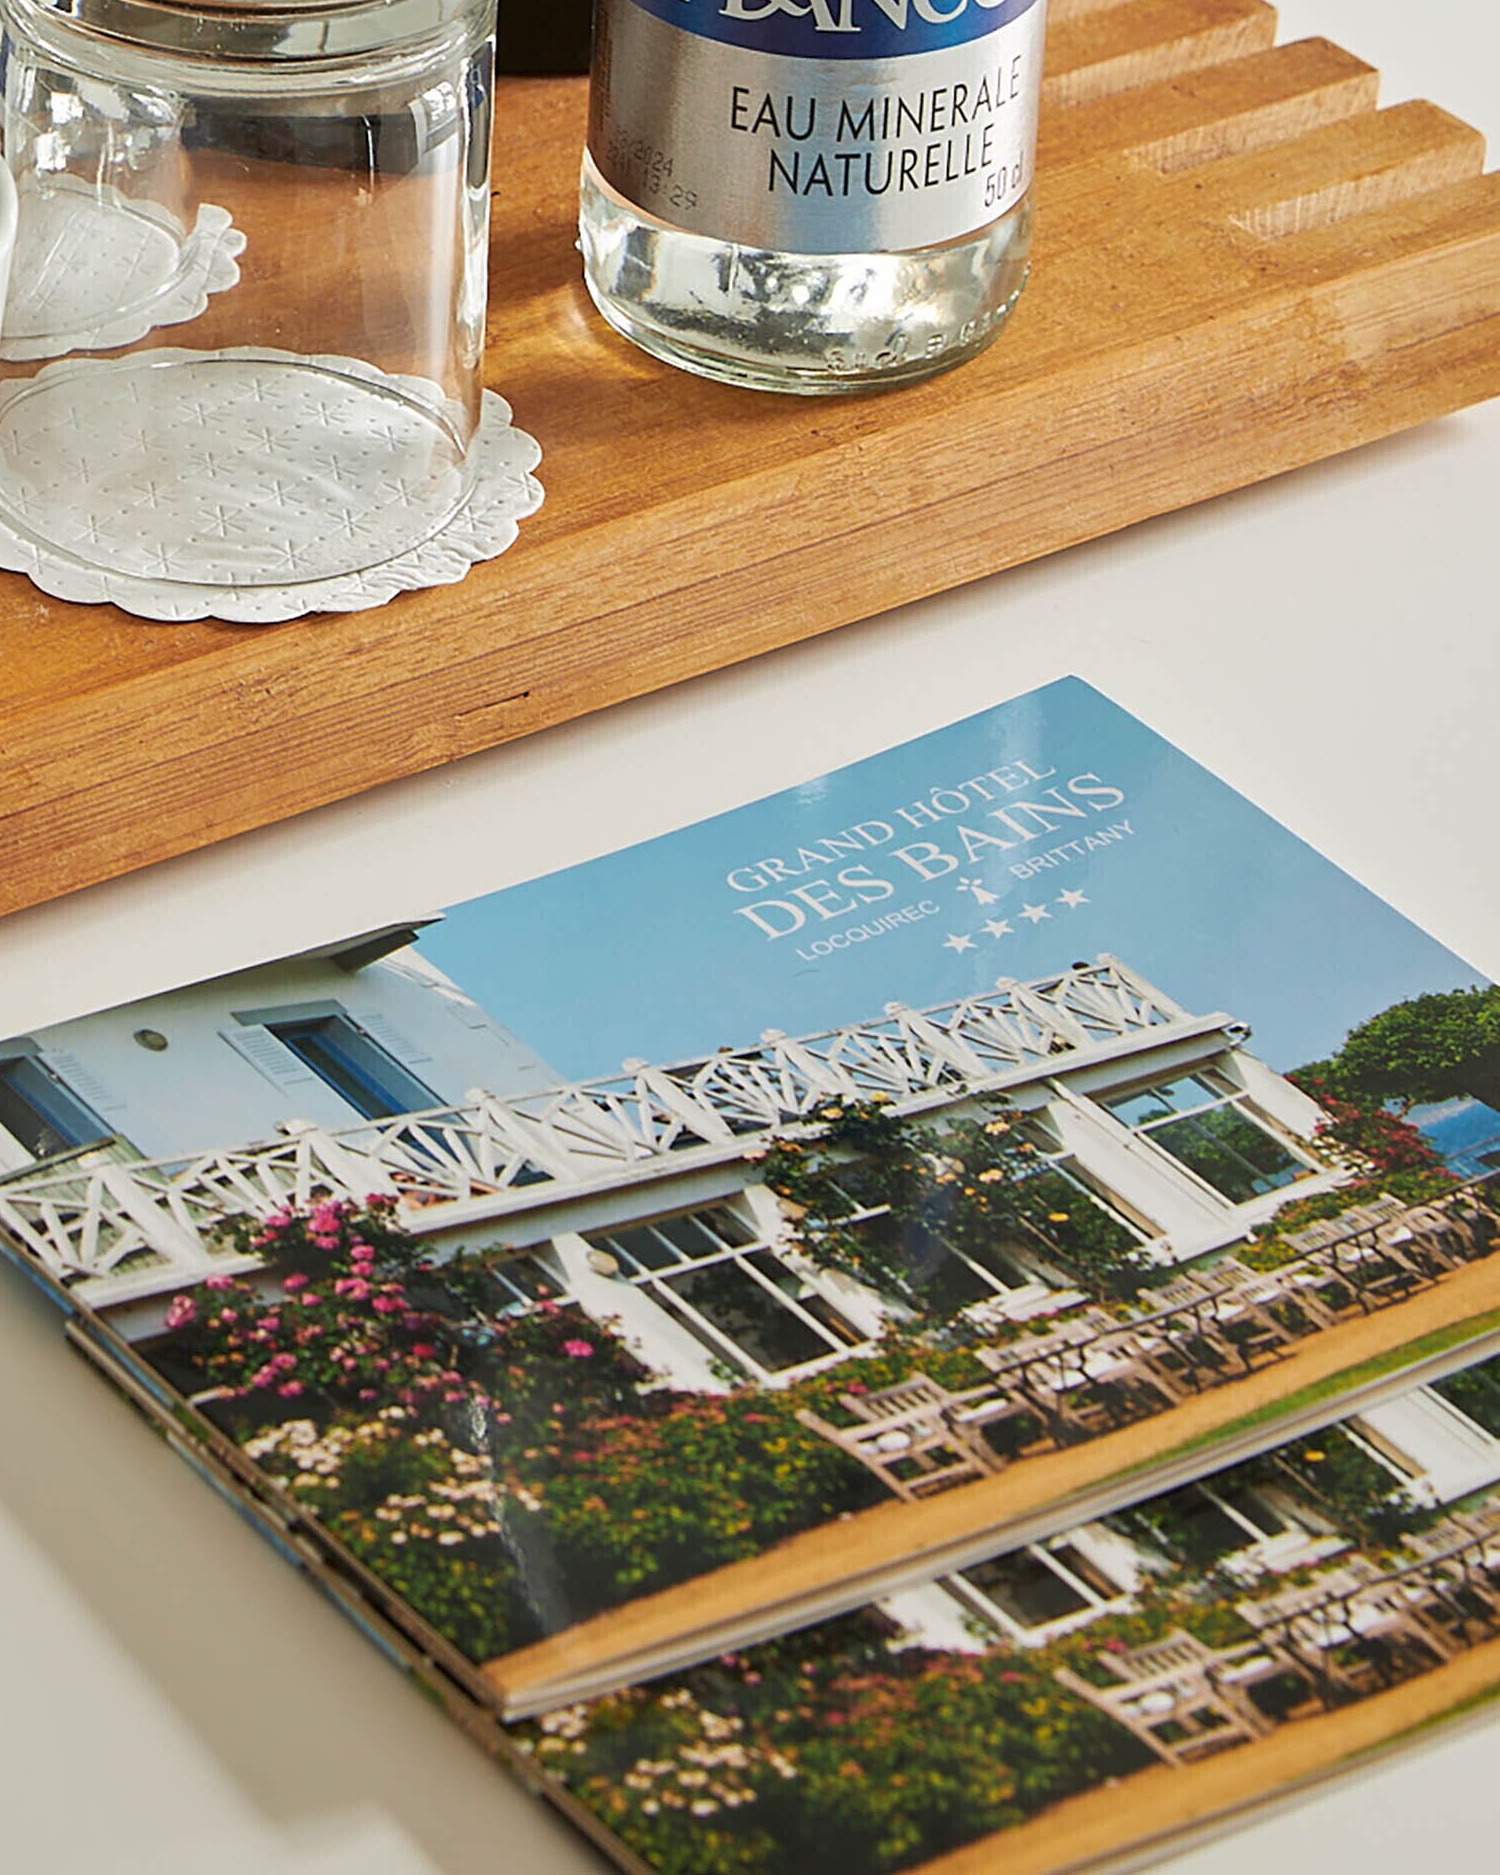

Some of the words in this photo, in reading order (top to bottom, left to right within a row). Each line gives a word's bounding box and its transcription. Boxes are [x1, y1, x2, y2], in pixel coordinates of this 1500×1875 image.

[730, 86, 816, 141] EAU
[836, 55, 1021, 142] MINERALE
[768, 124, 994, 196] NATURELLE
[984, 166, 1008, 207] 50
[726, 820, 895, 894] GRAND
[895, 759, 1057, 830] HÔTEL
[733, 865, 895, 941] DES
[890, 772, 1126, 882] BAINS
[796, 899, 941, 962] LOCQUIREC
[1008, 820, 1136, 881] BRITTANY
